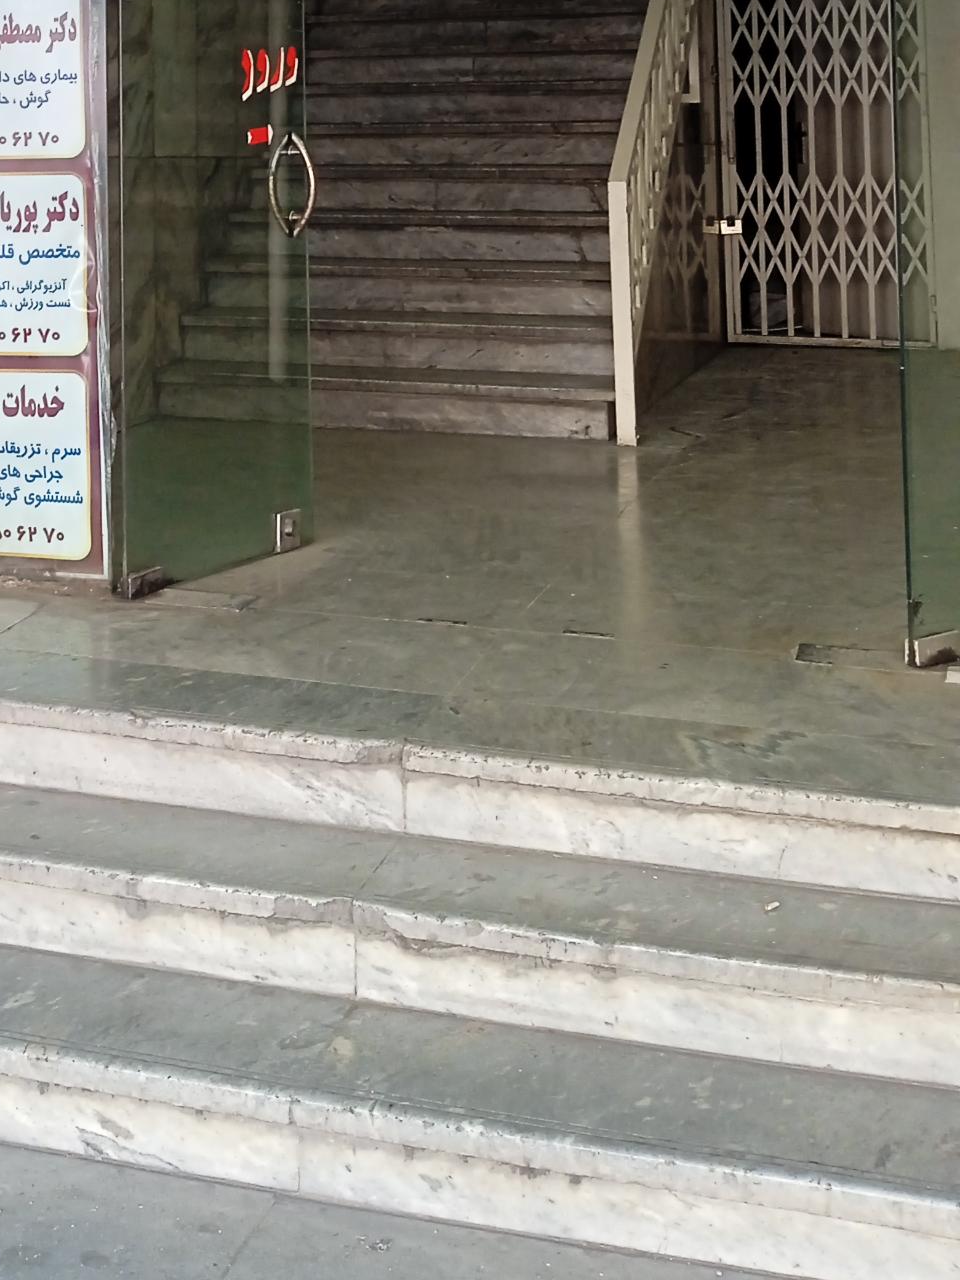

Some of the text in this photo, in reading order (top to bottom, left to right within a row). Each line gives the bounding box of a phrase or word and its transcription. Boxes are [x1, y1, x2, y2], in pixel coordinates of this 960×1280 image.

[46, 12, 76, 53] دکتر
[14, 70, 36, 85] های
[40, 69, 77, 84] بیماری
[0, 191, 38, 234] پوریا
[42, 191, 79, 232] دکتر
[19, 246, 80, 265] متخصص
[47, 296, 71, 309] تست
[3, 384, 64, 418] خدمات
[25, 466, 63, 483] جراحی
[24, 489, 83, 508] شستشوی
